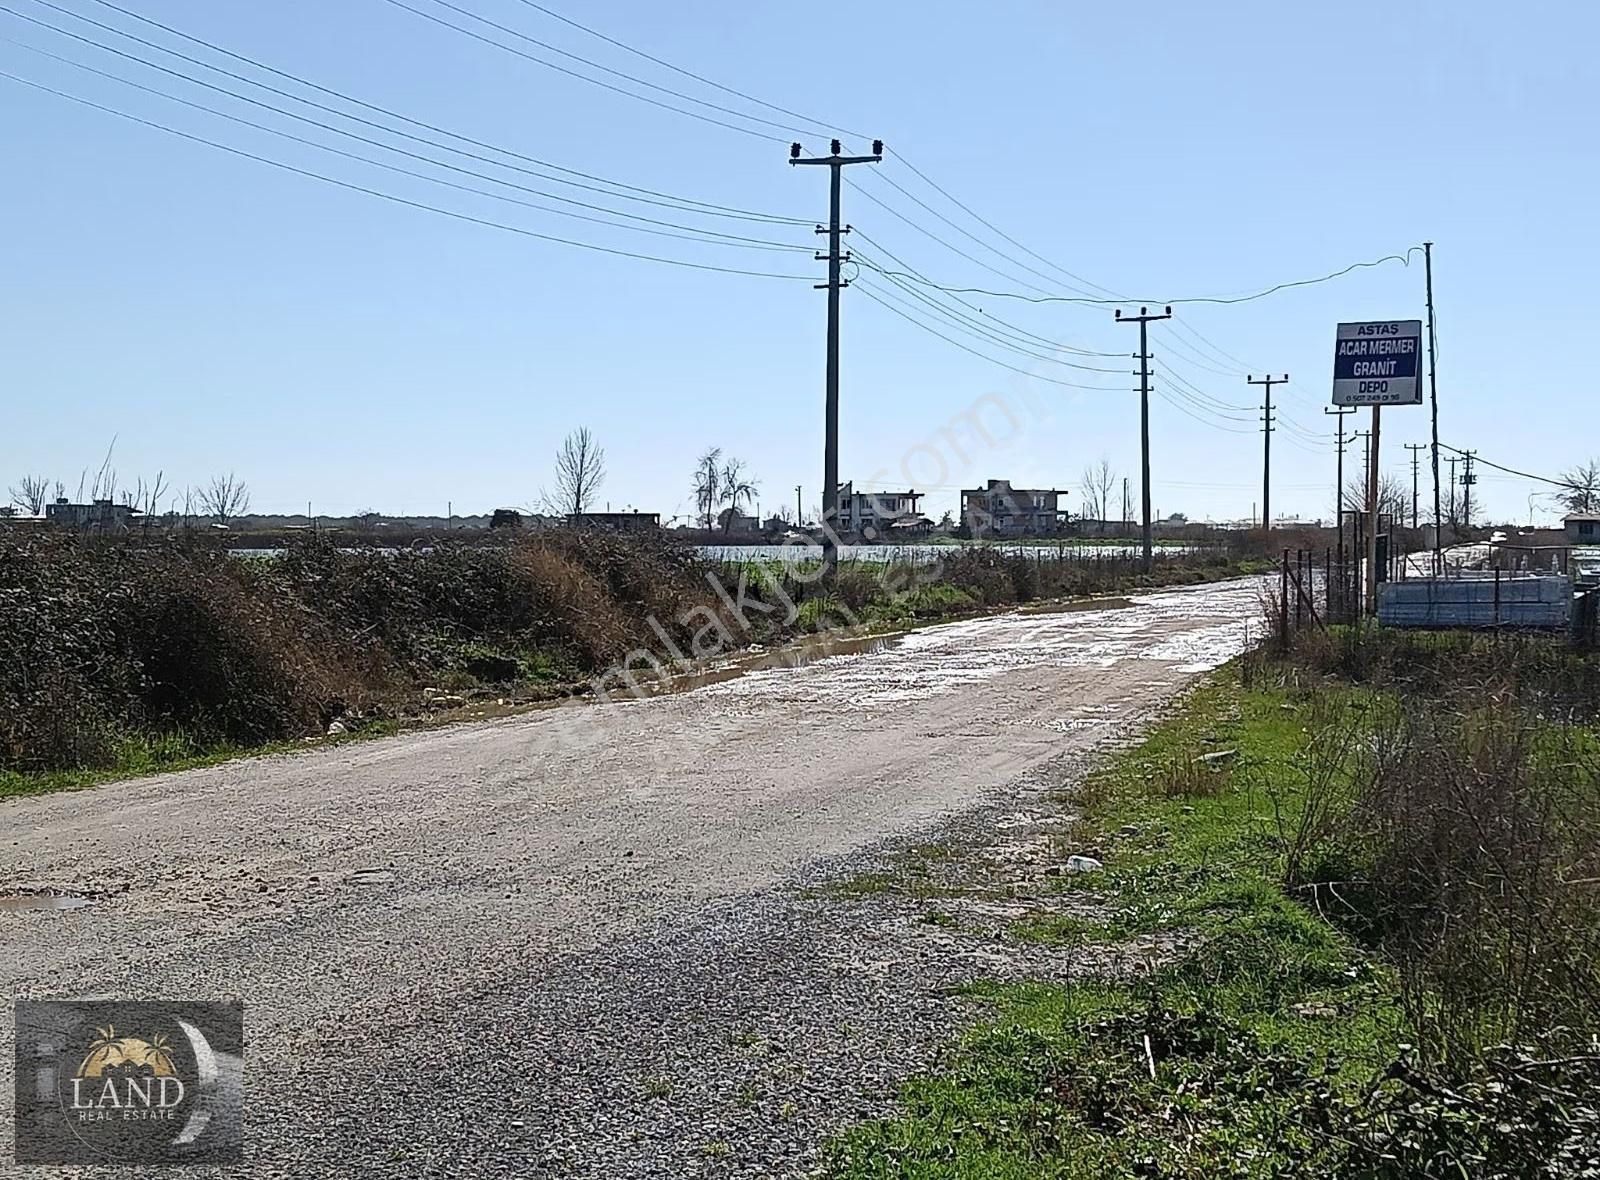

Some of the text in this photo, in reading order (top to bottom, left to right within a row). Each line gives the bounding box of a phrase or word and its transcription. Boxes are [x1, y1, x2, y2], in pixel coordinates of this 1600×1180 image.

[1339, 339, 1414, 356] ACAR MERMER
[1353, 358, 1397, 376] GRANİT
[1359, 380, 1388, 393] DEPO
